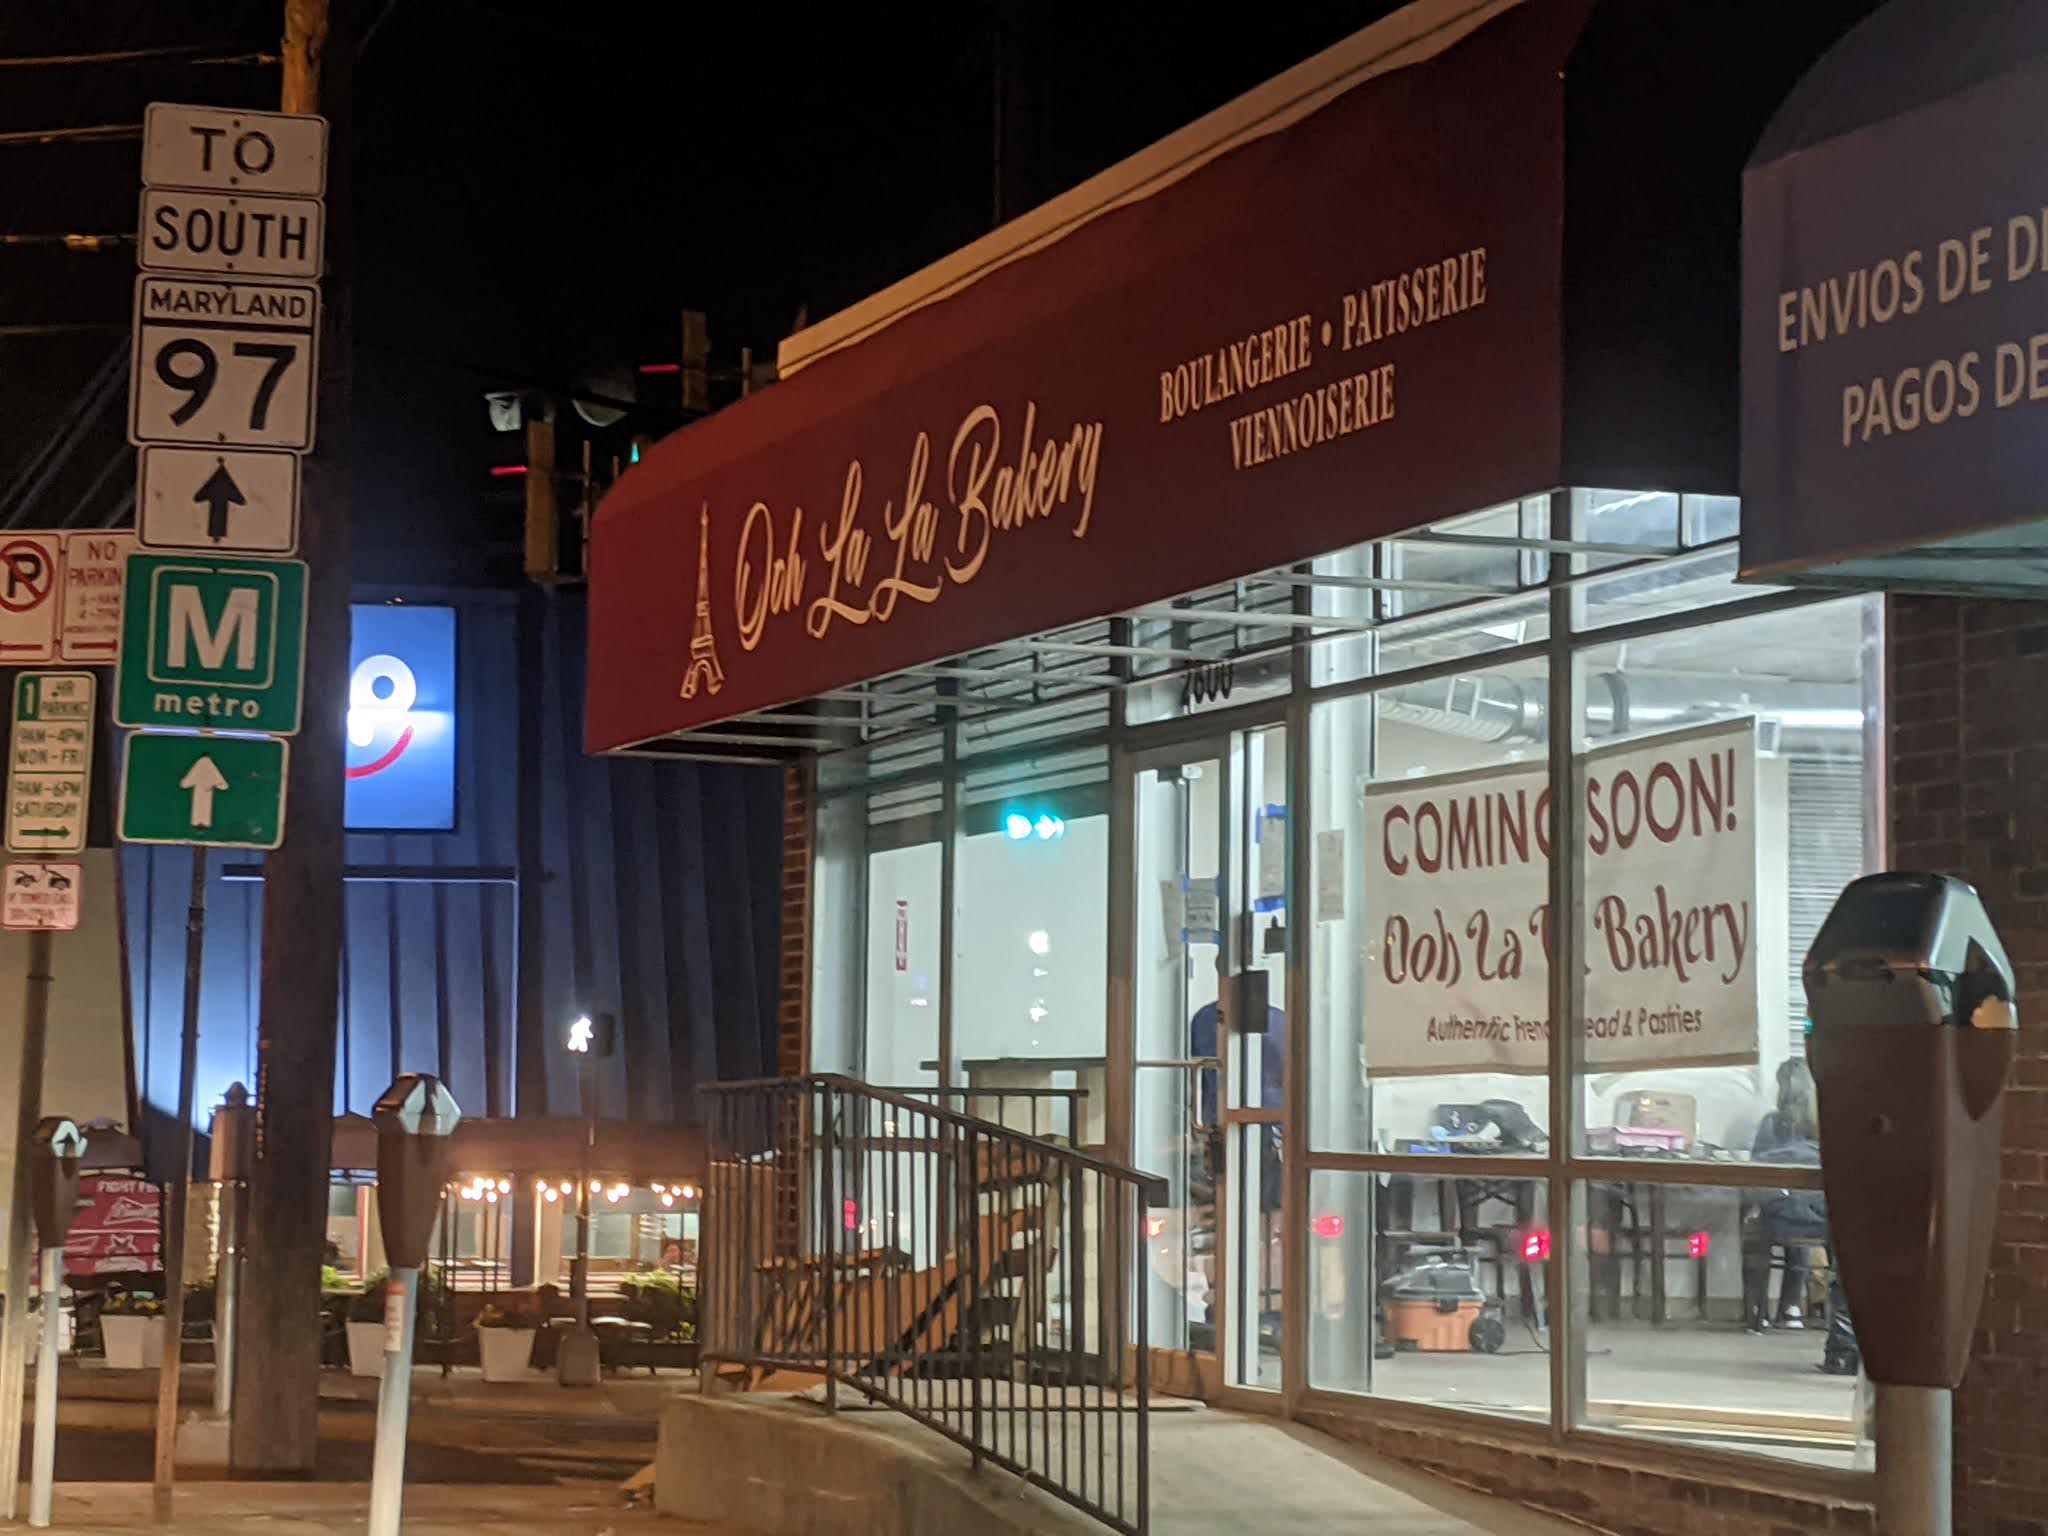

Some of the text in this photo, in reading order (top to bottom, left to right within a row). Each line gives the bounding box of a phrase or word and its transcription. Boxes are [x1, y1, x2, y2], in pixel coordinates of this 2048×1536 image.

[190, 125, 275, 175] TO
[152, 205, 308, 261] SOUTH
[150, 288, 307, 320] MARYLAND
[1778, 249, 1926, 353] ENVIOS
[1937, 226, 1993, 304] DE
[1159, 246, 1488, 424] BOULANGERIE PATISSERIE
[155, 337, 298, 431] 97
[1229, 363, 1396, 471] VIENNOISERIE
[1842, 332, 2048, 449] PAGOS DE
[88, 541, 117, 561] NO
[735, 400, 1104, 652] Ooh La La Bakery
[68, 567, 122, 587] PARKIN
[166, 584, 260, 672] M
[153, 691, 261, 720] metro
[13, 801, 77, 819] SATURDAY
[1586, 748, 1738, 857] SOON!
[1383, 908, 1462, 989] Ooh
[1465, 908, 1524, 982] La
[1594, 884, 1749, 985] Bakery
[1426, 1013, 1511, 1043] Authentic
[1512, 1013, 1551, 1042] Fren
[1582, 1008, 1621, 1039] ead
[1637, 1003, 1704, 1037] Pastries
